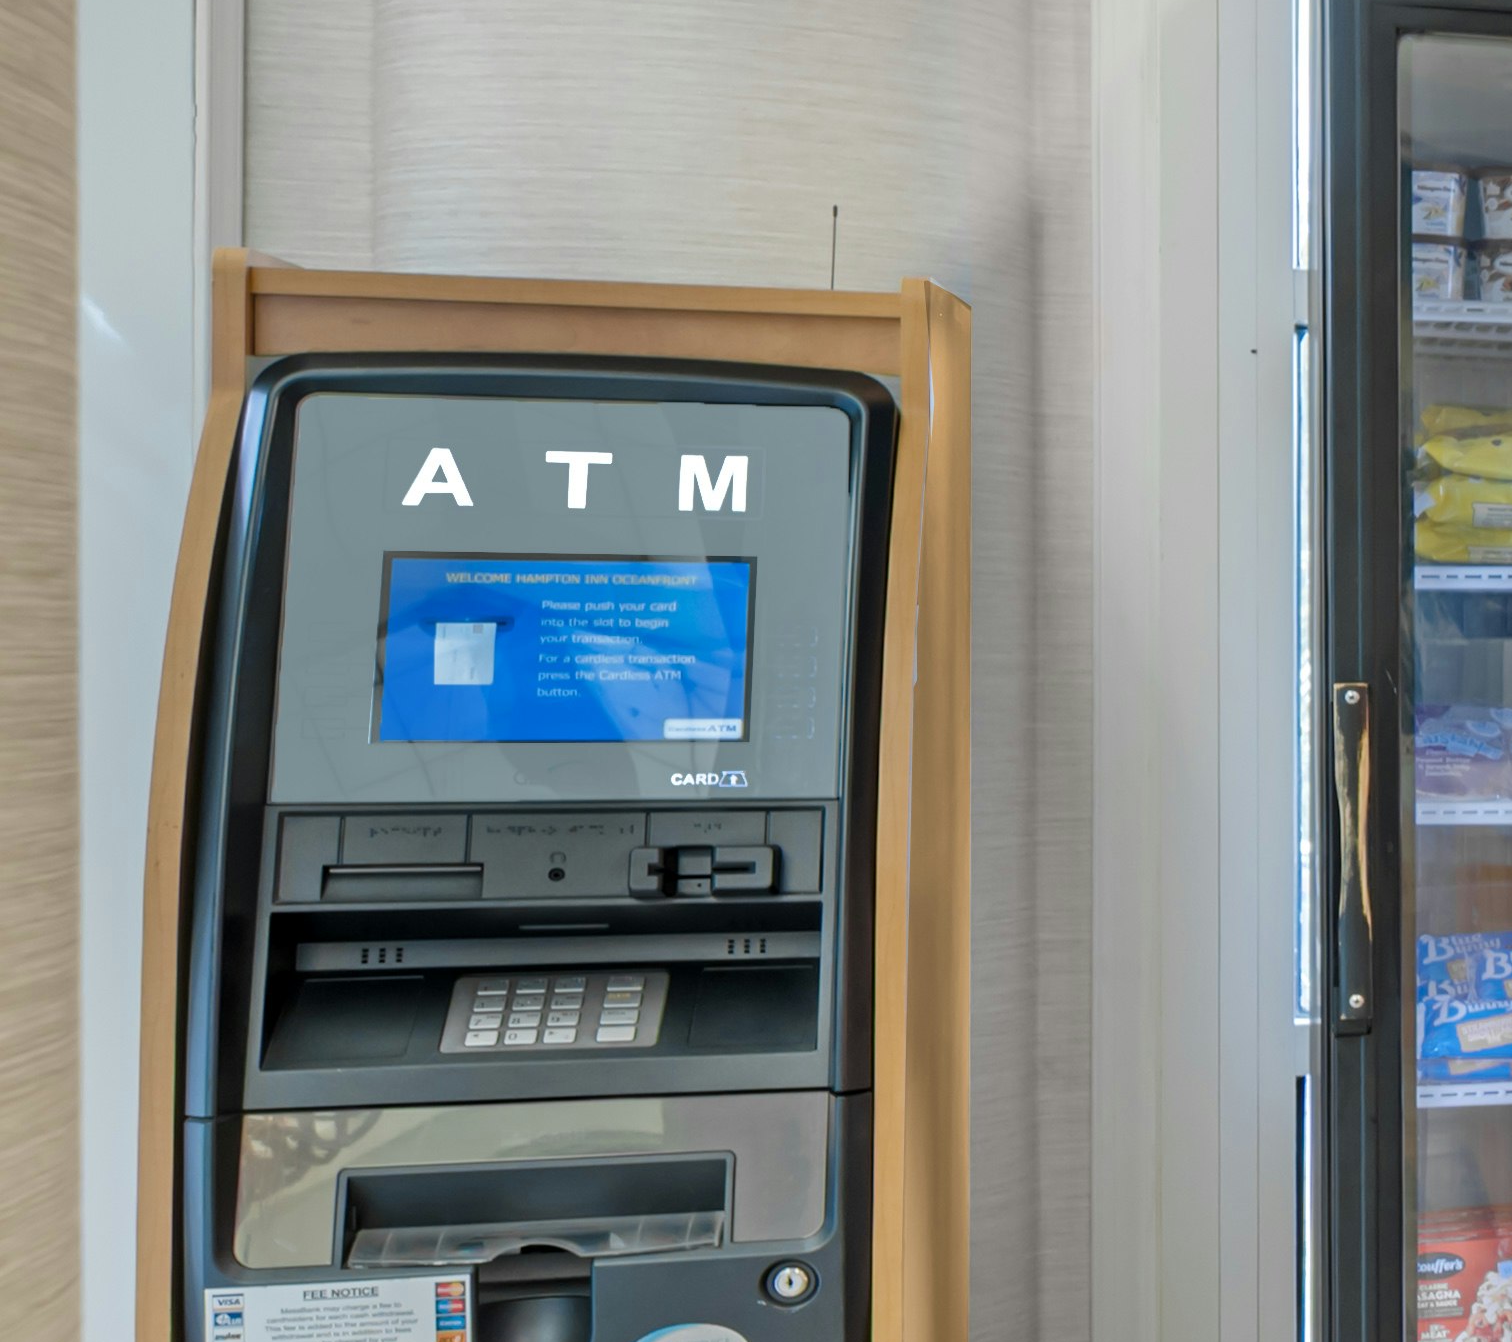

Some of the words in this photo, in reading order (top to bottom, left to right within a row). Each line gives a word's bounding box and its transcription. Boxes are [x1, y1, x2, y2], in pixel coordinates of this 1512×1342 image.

[446, 572, 511, 584] WELCOME
[516, 573, 580, 584] HAMPTON
[585, 574, 608, 584] INN
[542, 600, 580, 611] Please
[585, 601, 615, 613] push
[619, 601, 645, 613] your
[649, 601, 677, 612] card
[541, 618, 564, 628] into
[569, 618, 588, 627] the
[619, 618, 631, 628] to
[635, 618, 669, 630] begin
[540, 634, 567, 645] your
[539, 654, 558, 663] For
[628, 654, 695, 664] transaction
[538, 671, 570, 682] press
[575, 671, 595, 680] the
[599, 670, 650, 680] Cardless
[654, 670, 681, 680] ATM
[707, 724, 736, 732] ATM
[670, 772, 718, 786] CARD
[303, 1289, 327, 1300] FEE
[332, 1287, 378, 1298] NOTICE
[217, 1298, 240, 1306] VISA
